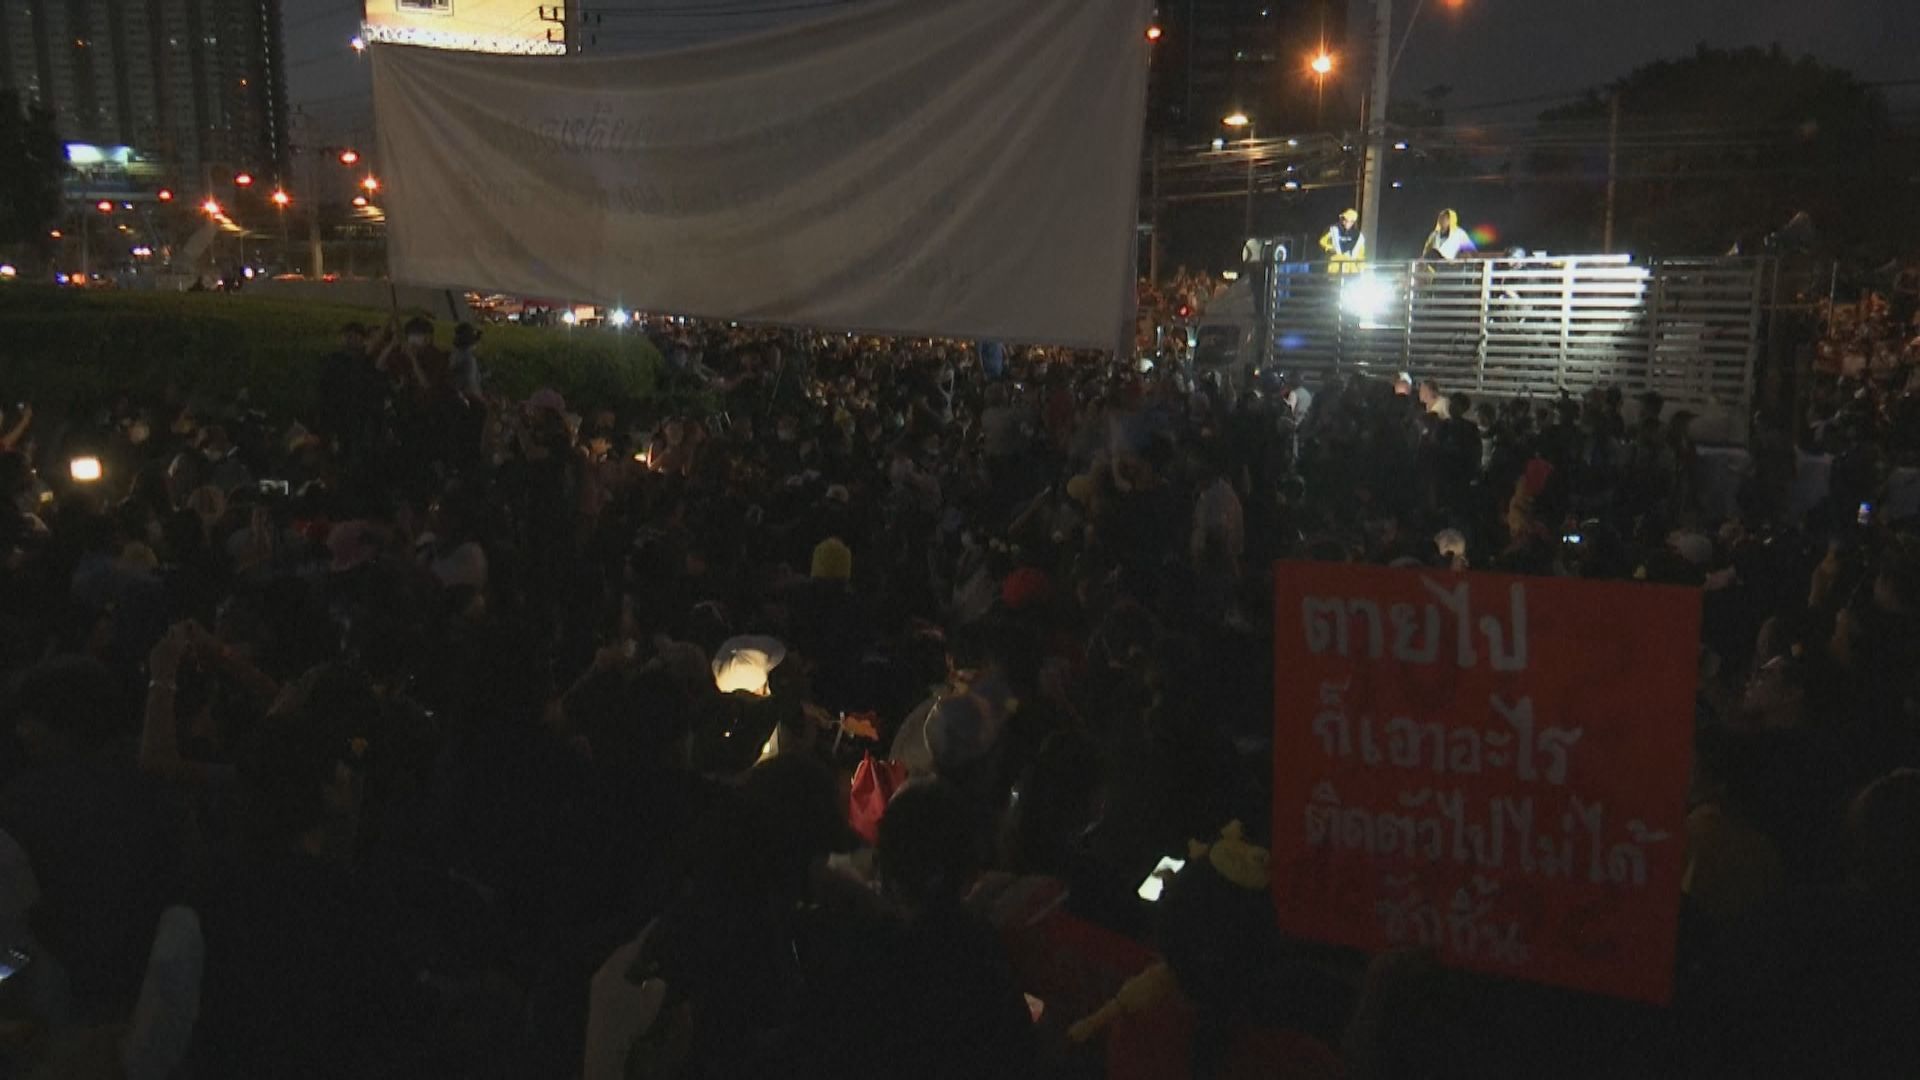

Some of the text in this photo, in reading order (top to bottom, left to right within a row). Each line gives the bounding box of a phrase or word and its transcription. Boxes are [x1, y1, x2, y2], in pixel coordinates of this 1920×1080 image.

[1301, 575, 1528, 671] ตายไป
[1312, 676, 1584, 785] ก็เอาอะไร
[1304, 779, 1671, 886] ติดตัวไปไม่ได้
